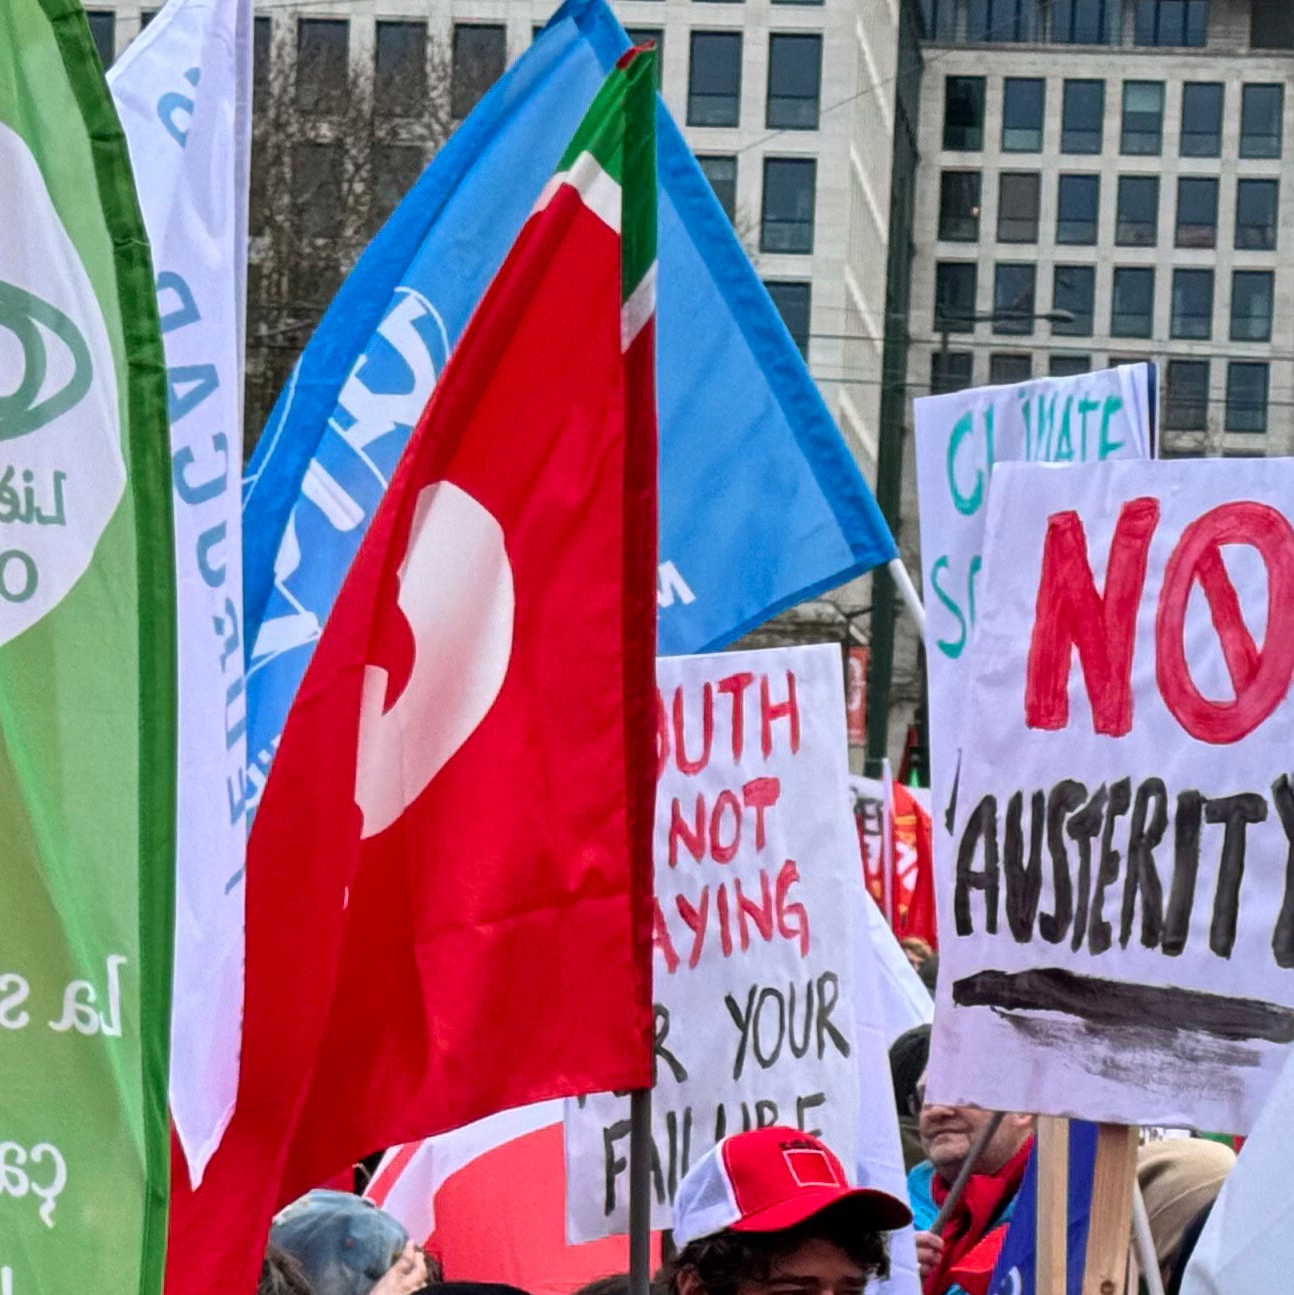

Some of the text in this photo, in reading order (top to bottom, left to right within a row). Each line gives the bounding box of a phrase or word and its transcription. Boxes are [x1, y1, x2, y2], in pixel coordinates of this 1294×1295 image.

[656, 670, 800, 777] UTH
[669, 776, 781, 868] NOT
[653, 860, 810, 974] AYING
[725, 971, 851, 1082] YOUR
